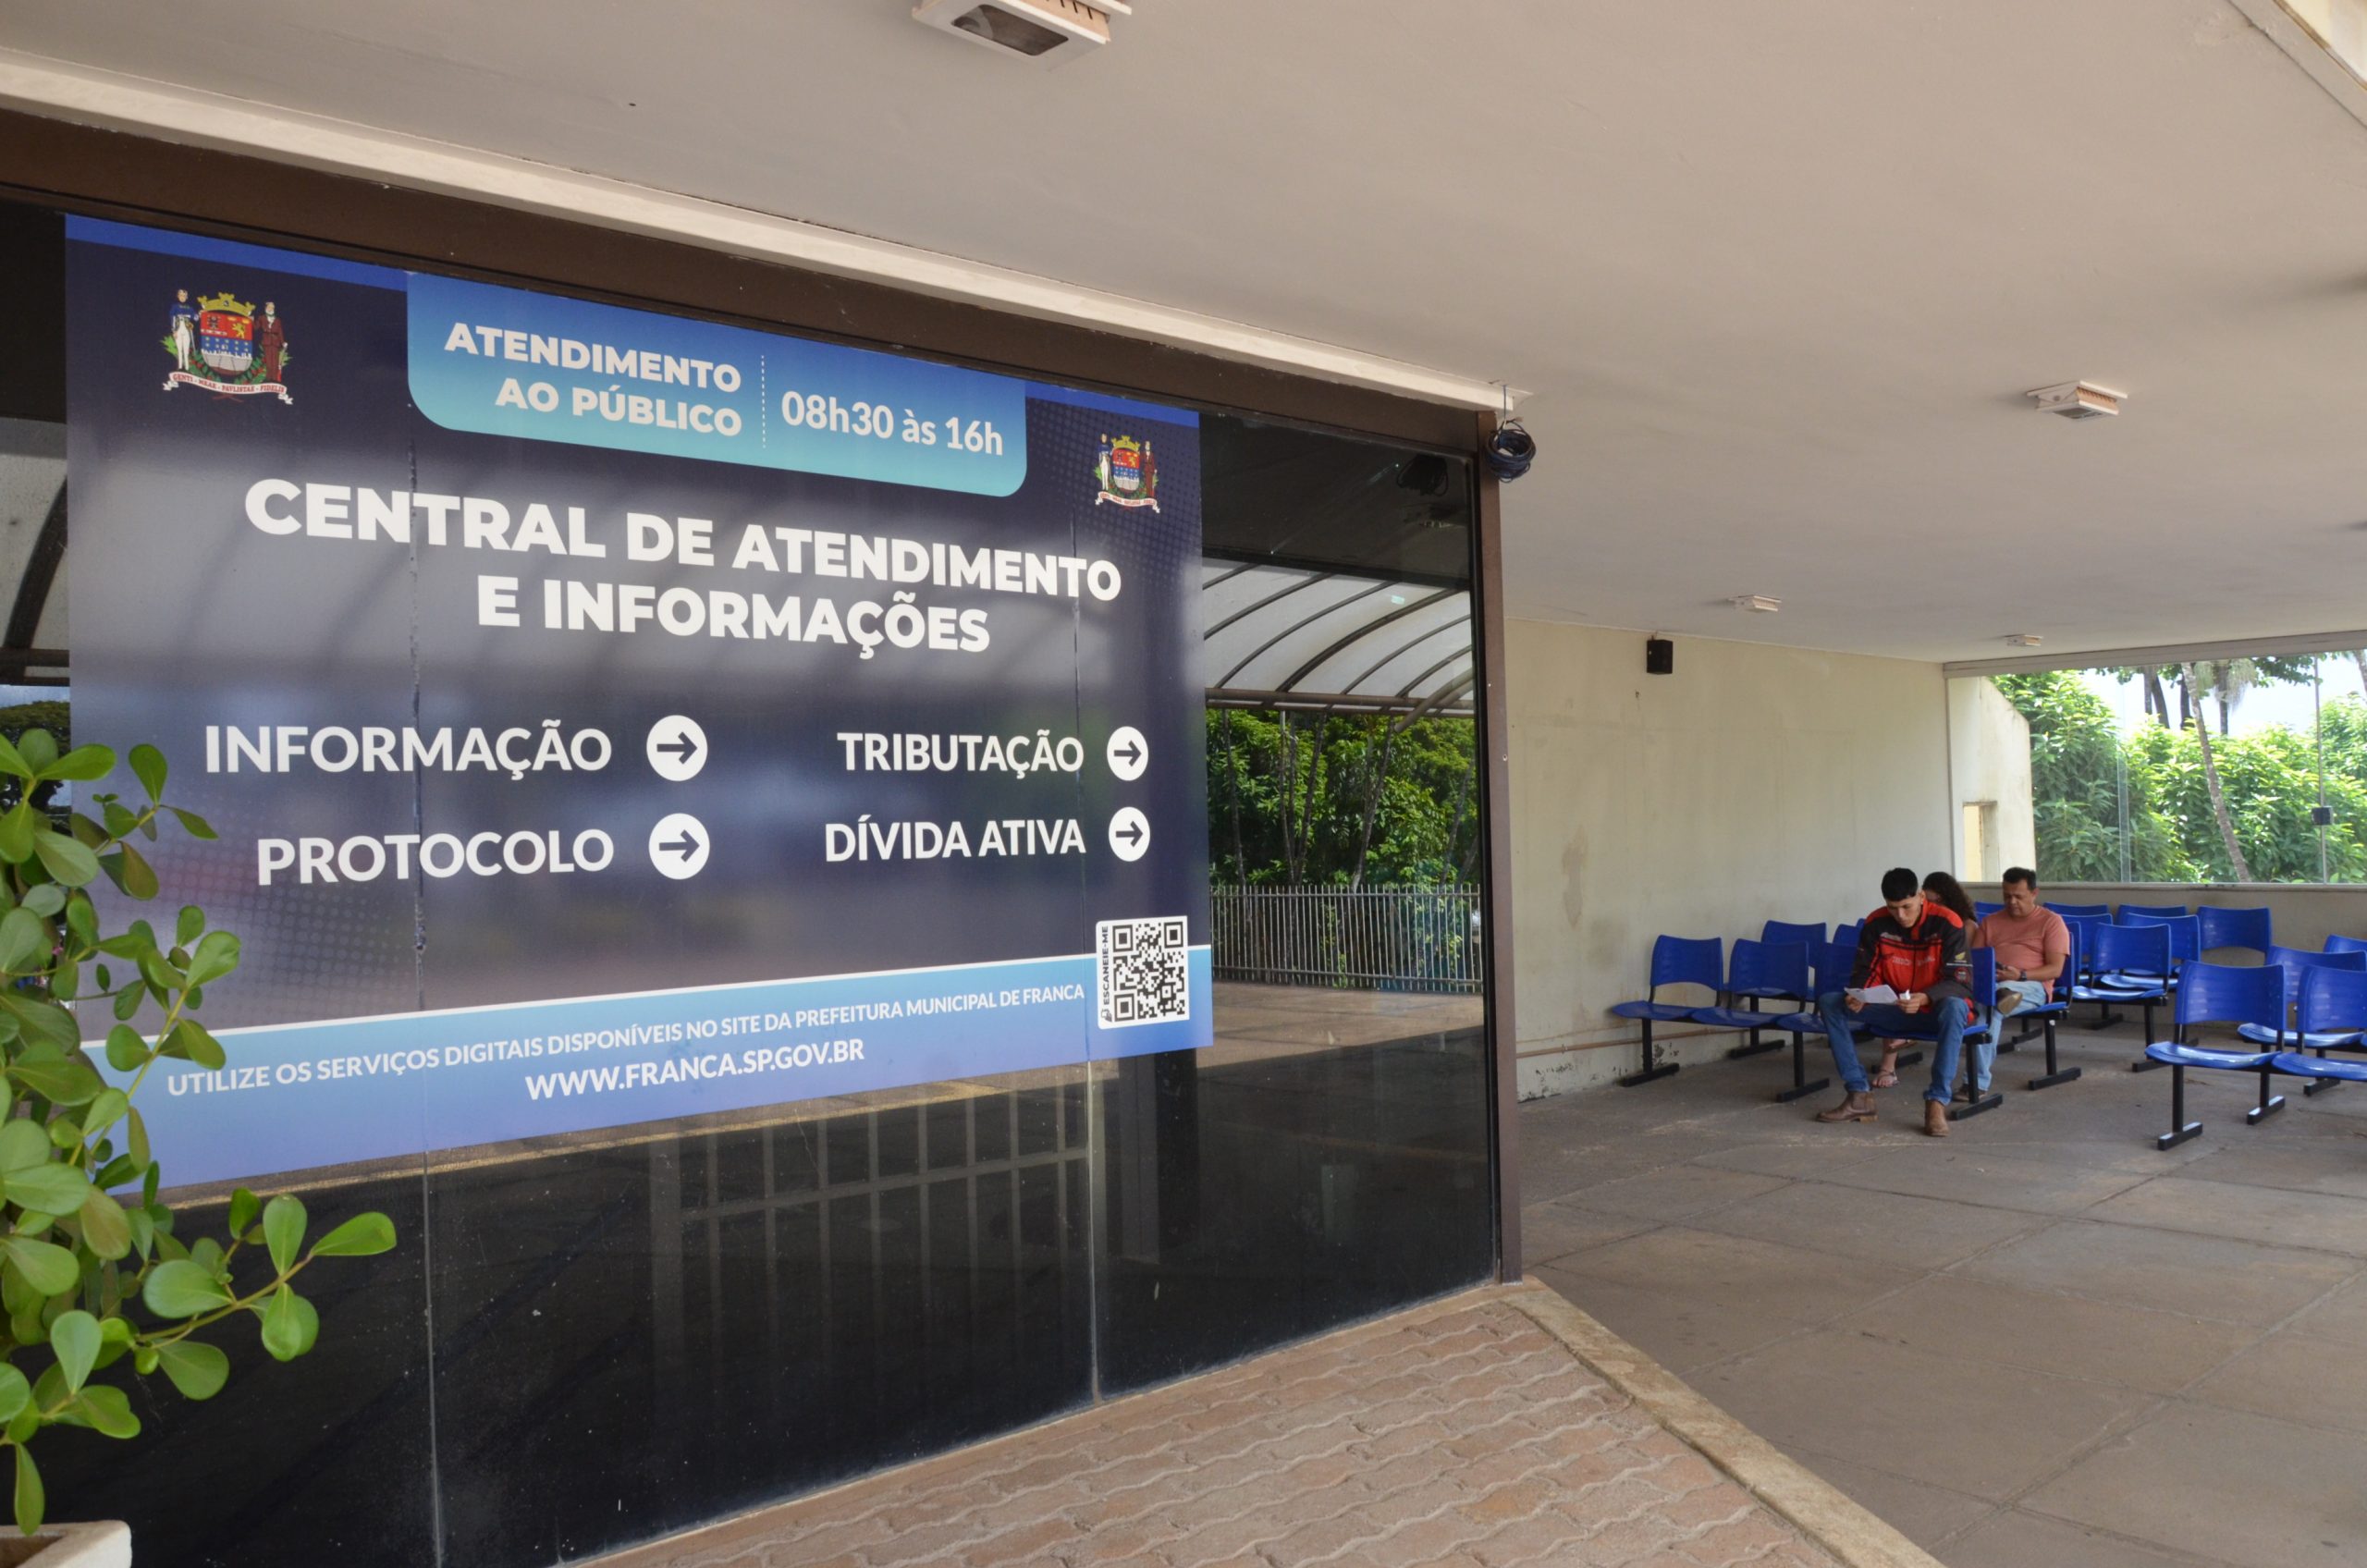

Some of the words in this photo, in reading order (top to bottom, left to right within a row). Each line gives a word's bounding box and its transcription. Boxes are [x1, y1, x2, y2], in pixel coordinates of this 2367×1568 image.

[444, 322, 742, 394] ATENDIMENTO
[495, 377, 559, 412] AO
[572, 385, 742, 437] PÚBLICO
[781, 390, 894, 439] 08h30
[901, 409, 937, 446] às
[945, 416, 1003, 456] 16h
[244, 478, 607, 558] CENTRAL
[626, 512, 715, 567] DE
[731, 523, 1122, 603] ATENDIMENTO
[477, 574, 521, 627] E
[543, 578, 992, 660] INFORMAÇÕES
[205, 718, 612, 781] INFORMAÇÃO
[837, 729, 1085, 779] TRIBUTAÇÃO
[257, 828, 615, 886] PROTOCOLO
[825, 814, 972, 863] DÍVIDA
[978, 818, 1086, 857] ATIVA
[1100, 925, 1110, 1006] ESCANEIE-ME
[167, 1065, 271, 1096] UTILIZE
[276, 1061, 313, 1084] OS
[316, 1047, 440, 1081] SERVIÇOS
[444, 1036, 544, 1066] DIGITAIS
[547, 1023, 683, 1055] DISPONÍVEIS
[686, 1019, 718, 1040] NO
[721, 1014, 761, 1036] SITE
[764, 1011, 792, 1032] DA
[795, 1000, 904, 1028] PREFEITURA
[906, 991, 998, 1017] MUNICIPAL
[1000, 989, 1021, 1007] DE
[1023, 984, 1085, 1005] FRANCA
[523, 1038, 865, 1100] WWW.FRANCA.SP.GOV.BR
